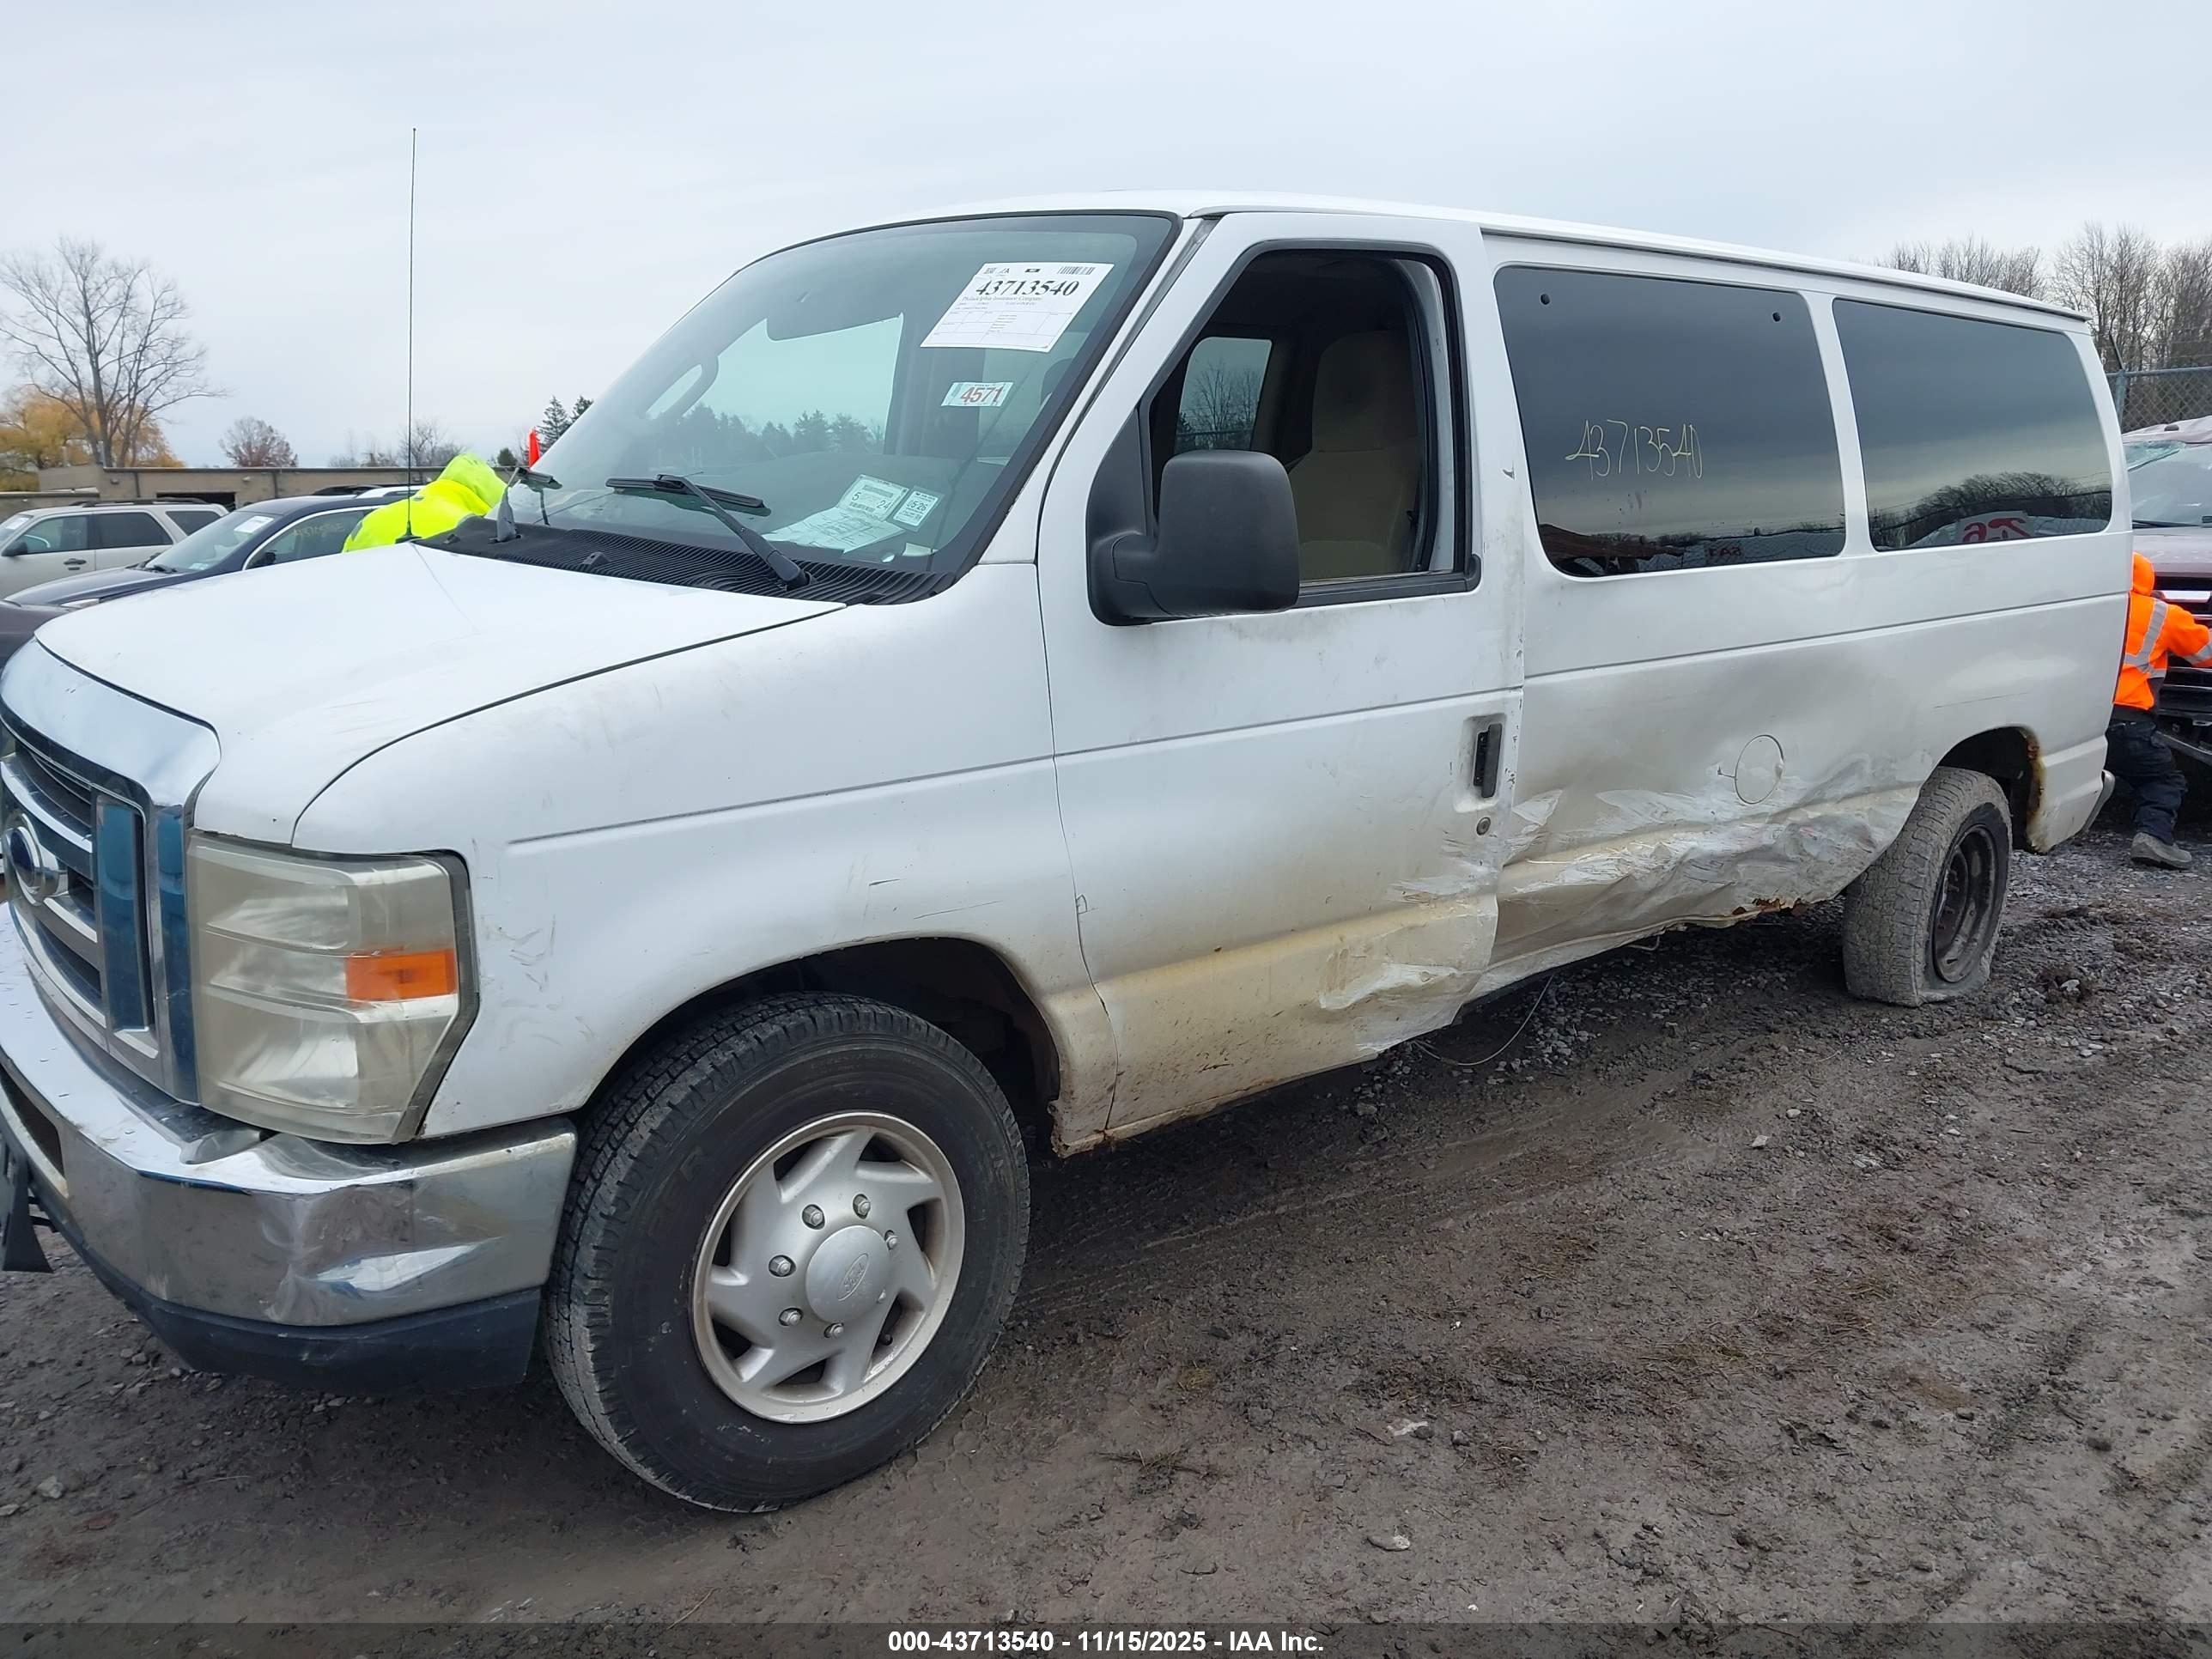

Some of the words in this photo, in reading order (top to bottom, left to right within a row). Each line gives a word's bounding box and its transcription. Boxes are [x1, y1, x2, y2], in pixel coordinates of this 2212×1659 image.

[975, 280, 1079, 296] 43713540
[960, 386, 1004, 403] 4571
[1565, 419, 1703, 481] 43713540
[852, 491, 862, 501] 5
